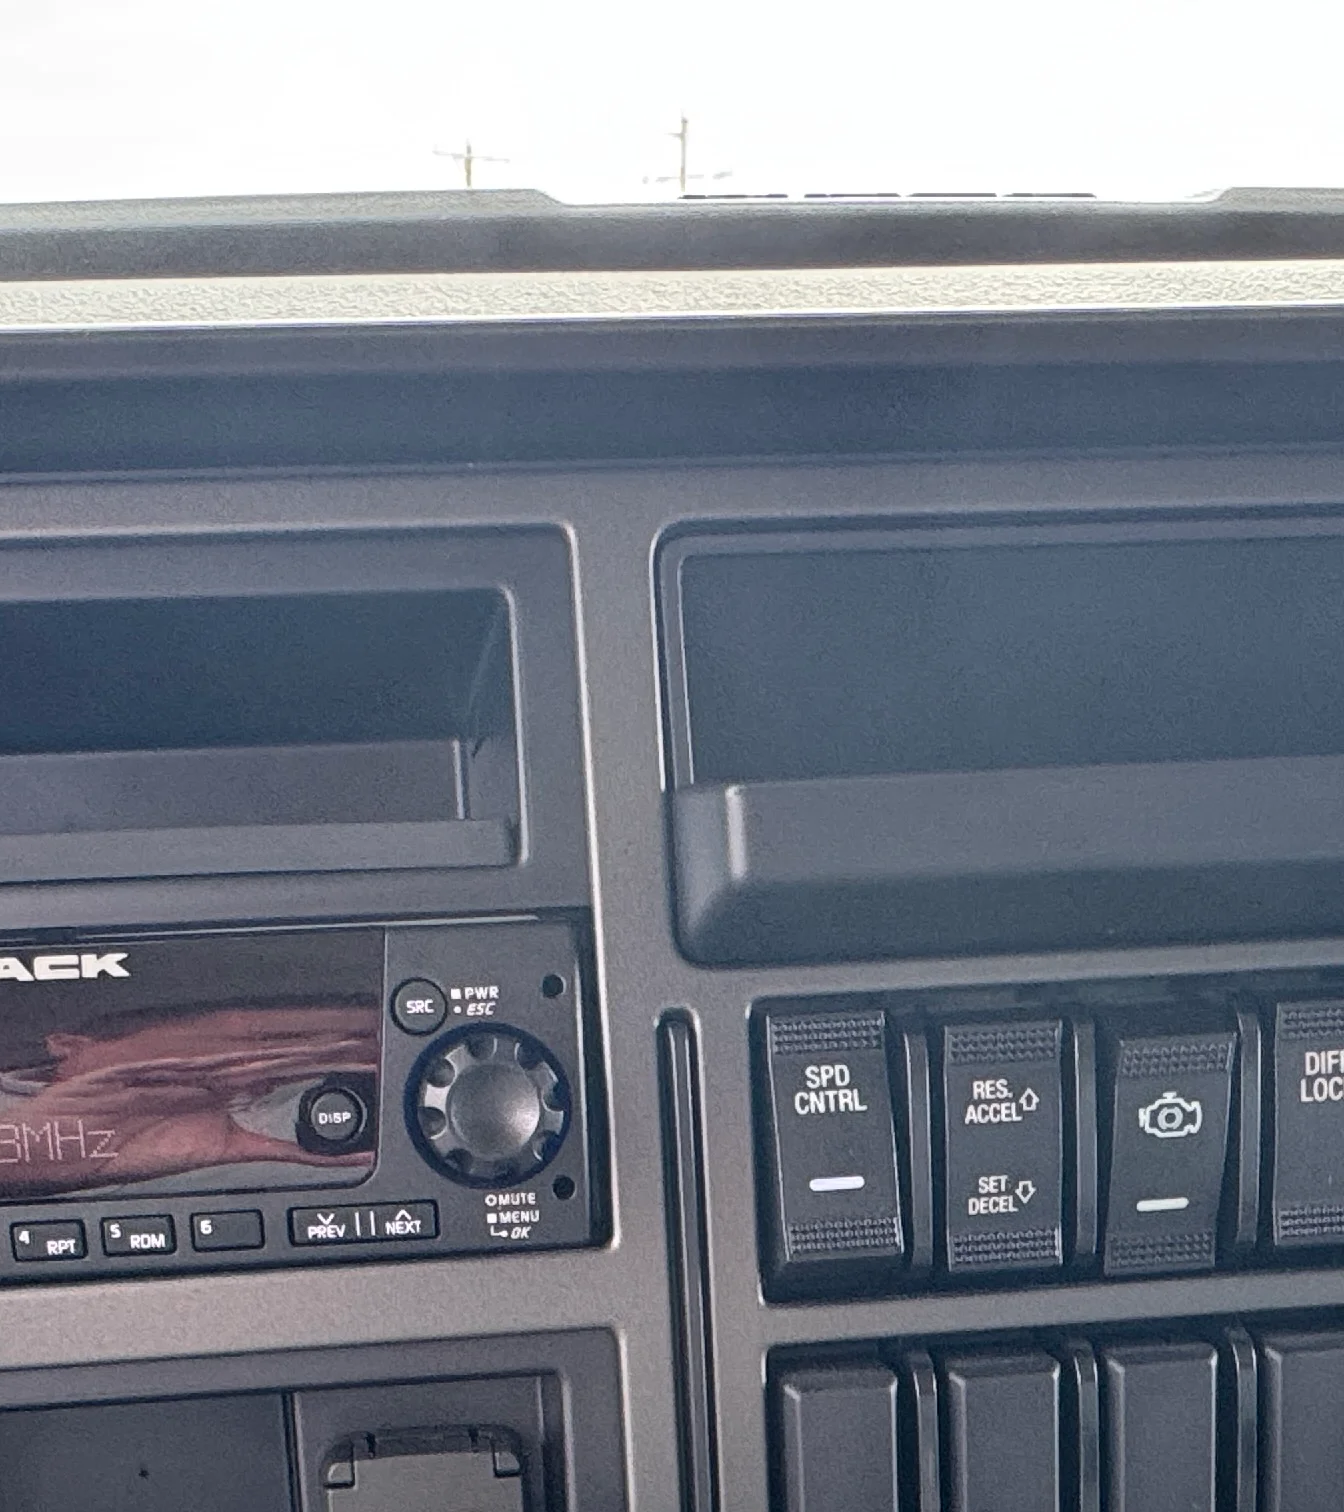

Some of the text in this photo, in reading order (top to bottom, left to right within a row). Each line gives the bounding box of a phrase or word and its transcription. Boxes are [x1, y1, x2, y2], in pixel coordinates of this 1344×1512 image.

[464, 985, 500, 1000] PWR
[406, 998, 435, 1014] SRC
[466, 1001, 497, 1016] ESC
[805, 1063, 850, 1088] SPD
[972, 1078, 1013, 1100] RES.
[794, 1088, 868, 1116] CNTRL
[317, 1110, 353, 1125] DISP
[964, 1100, 1023, 1125] ACCEL
[978, 1175, 1009, 1194] SET
[498, 1192, 536, 1206] MUTE
[967, 1195, 1019, 1215] DECEL
[499, 1209, 540, 1223] MENU
[109, 1223, 122, 1239] 5
[200, 1219, 212, 1234] 6
[307, 1221, 347, 1239] PREV
[385, 1217, 423, 1235] NEXT
[510, 1226, 532, 1240] OK
[18, 1230, 31, 1245] 4
[129, 1233, 166, 1249] RDM
[46, 1239, 76, 1256] RPT
